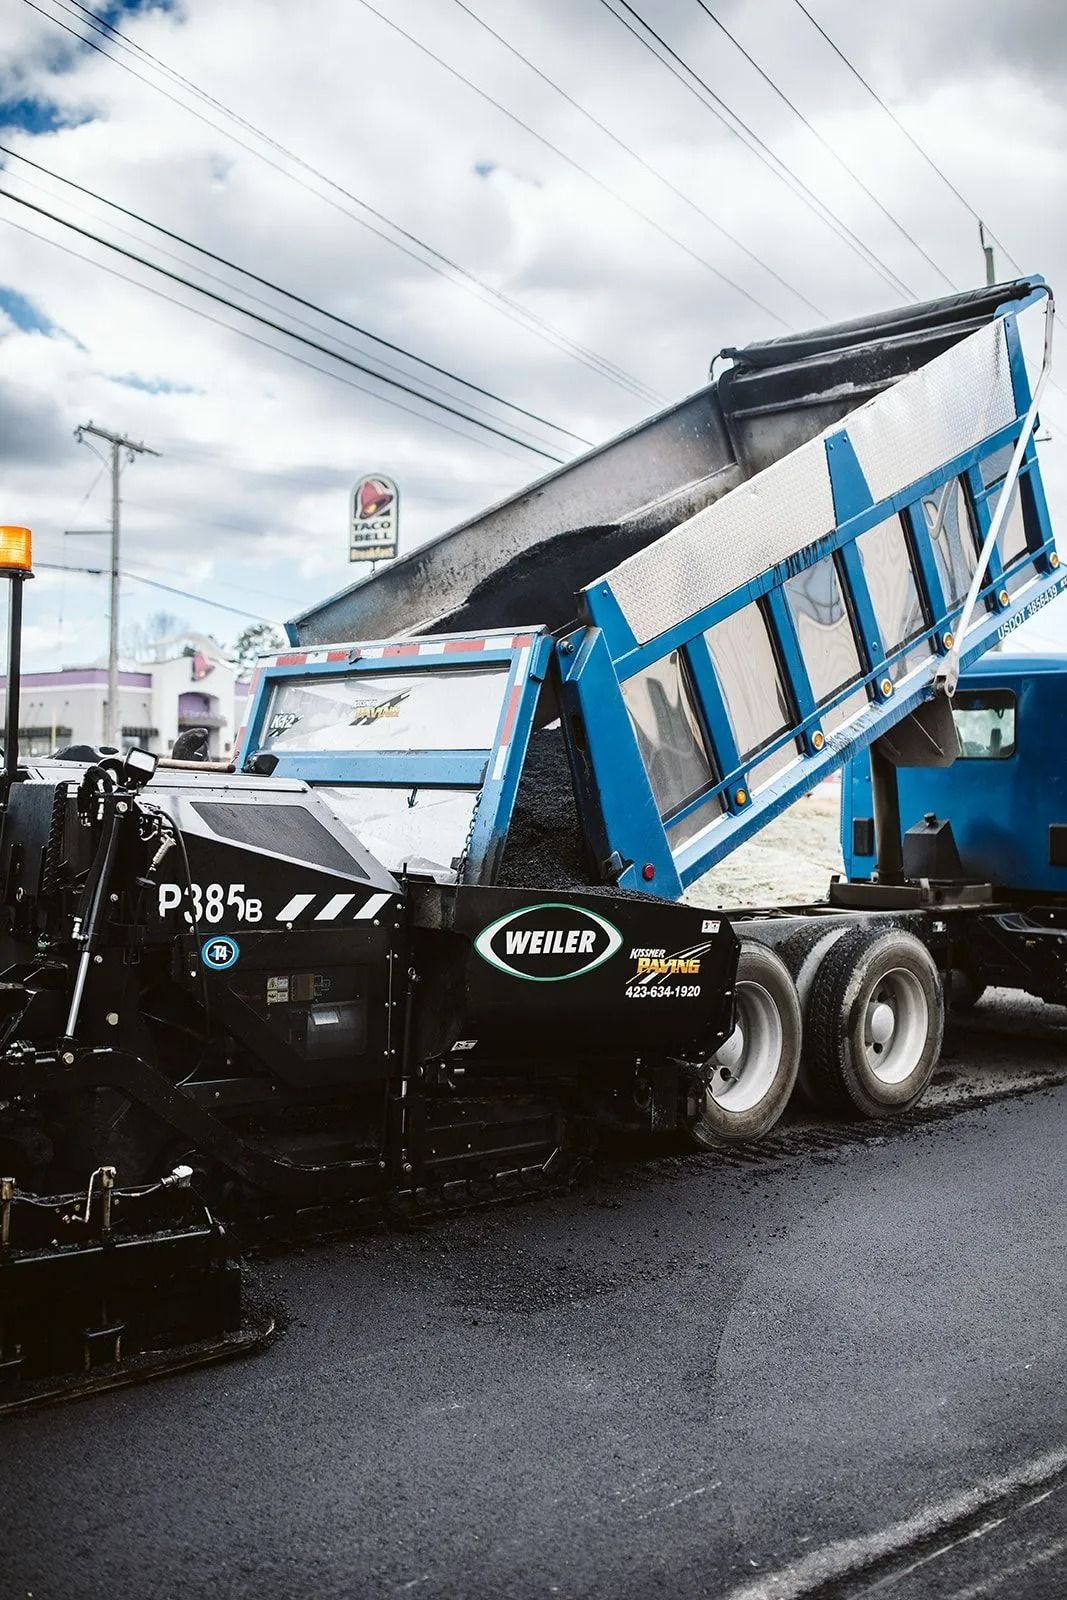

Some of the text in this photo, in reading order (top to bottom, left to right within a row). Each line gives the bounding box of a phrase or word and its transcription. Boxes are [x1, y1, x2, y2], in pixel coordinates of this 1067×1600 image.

[353, 521, 391, 531] TACO
[354, 532, 392, 542] BELL
[997, 608, 1026, 640] USDOT
[505, 930, 597, 955] WEILER
[213, 945, 228, 961] T4
[629, 948, 667, 960] KISSNER
[636, 957, 701, 974] PAVING
[625, 985, 701, 998] 423-634-1920
